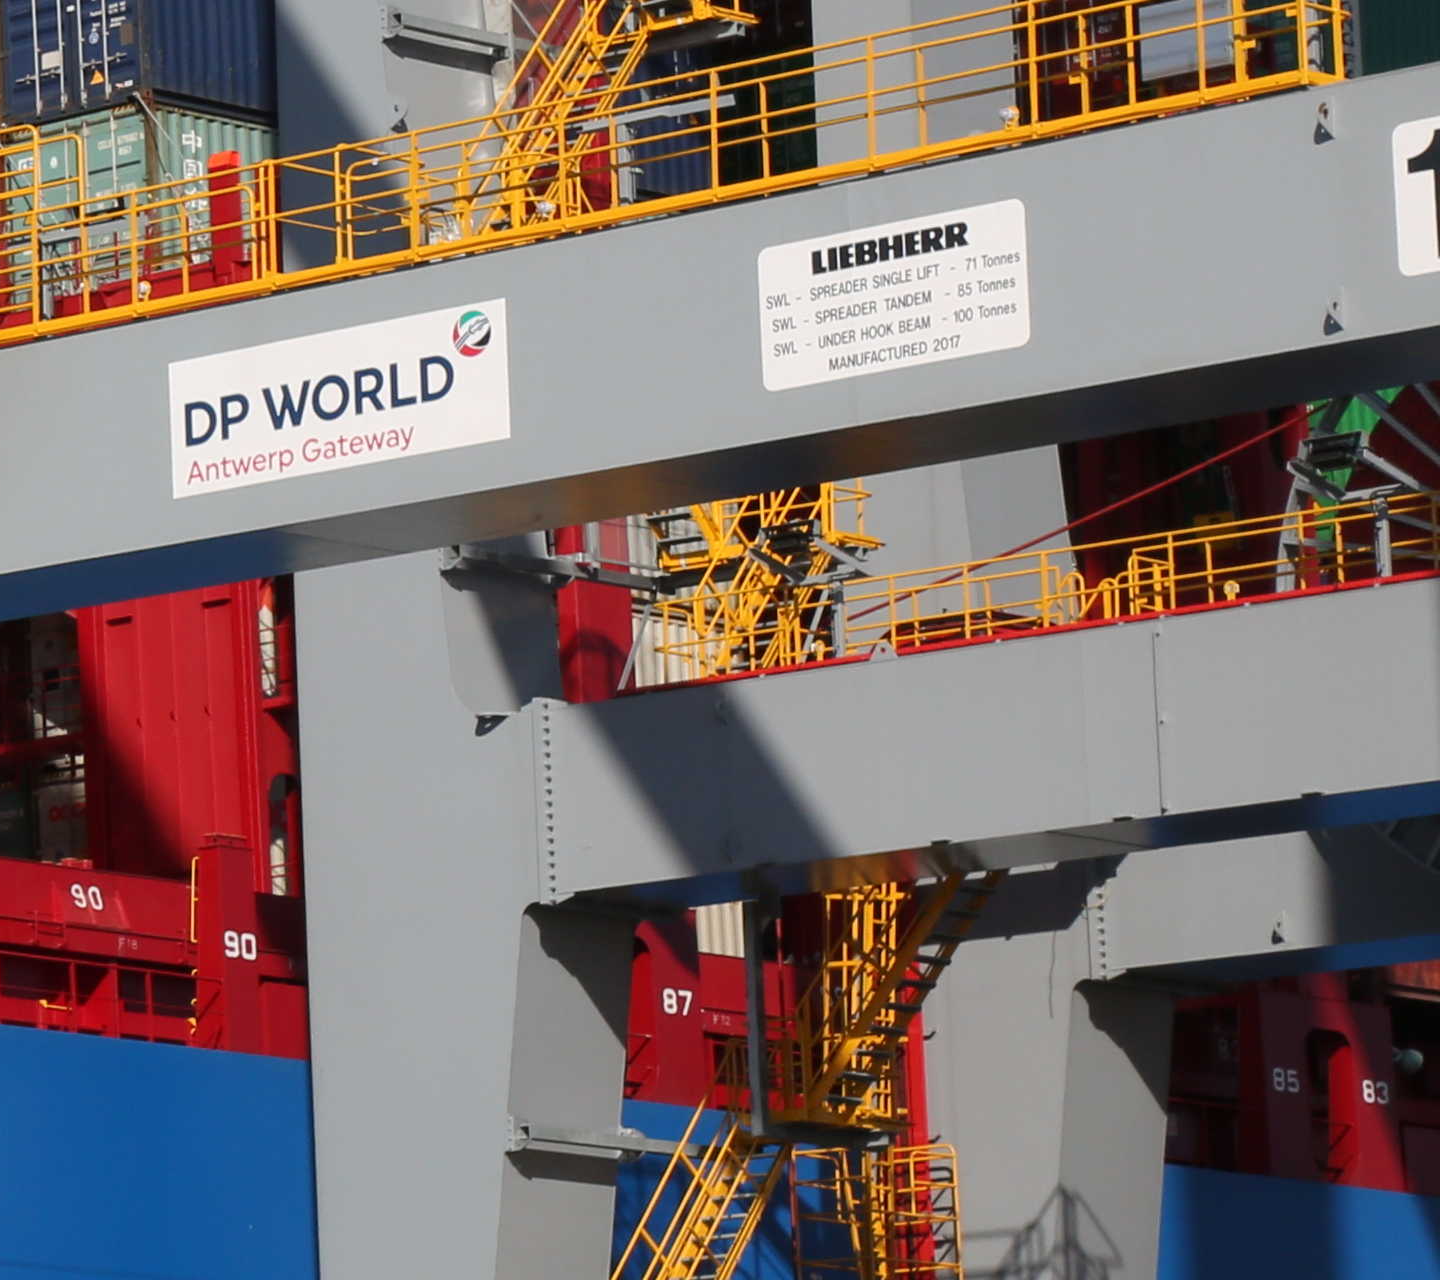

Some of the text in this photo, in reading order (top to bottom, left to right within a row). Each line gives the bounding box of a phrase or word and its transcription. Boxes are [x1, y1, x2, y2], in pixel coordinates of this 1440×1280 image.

[810, 221, 969, 275] LIEBHERR
[765, 293, 791, 310] SWL
[809, 278, 868, 302] SPREADER
[872, 269, 913, 290] SINGLE
[916, 263, 940, 281] LIFT
[965, 256, 978, 271] 71
[981, 251, 1021, 269] Tonnes
[771, 317, 797, 333] SWL
[814, 301, 878, 325] SPREADER
[884, 290, 933, 312] TANDEM
[957, 282, 972, 298] 85
[976, 276, 1016, 295] Tonnes
[773, 341, 798, 358] SWL
[817, 329, 856, 350] UNDER
[860, 323, 895, 342] HOOK
[898, 315, 932, 335] BEAM
[952, 307, 974, 324] 100
[979, 301, 1017, 320] Tonnes
[828, 334, 962, 372] MANUFACTURED 2017
[184, 355, 455, 448] DP WORLD
[187, 425, 415, 486] Antwerp Gateway
[71, 883, 104, 911] 90
[224, 930, 257, 961] 90
[662, 988, 692, 1016] 87
[1272, 1067, 1301, 1093] 85
[1362, 1079, 1389, 1105] 83
